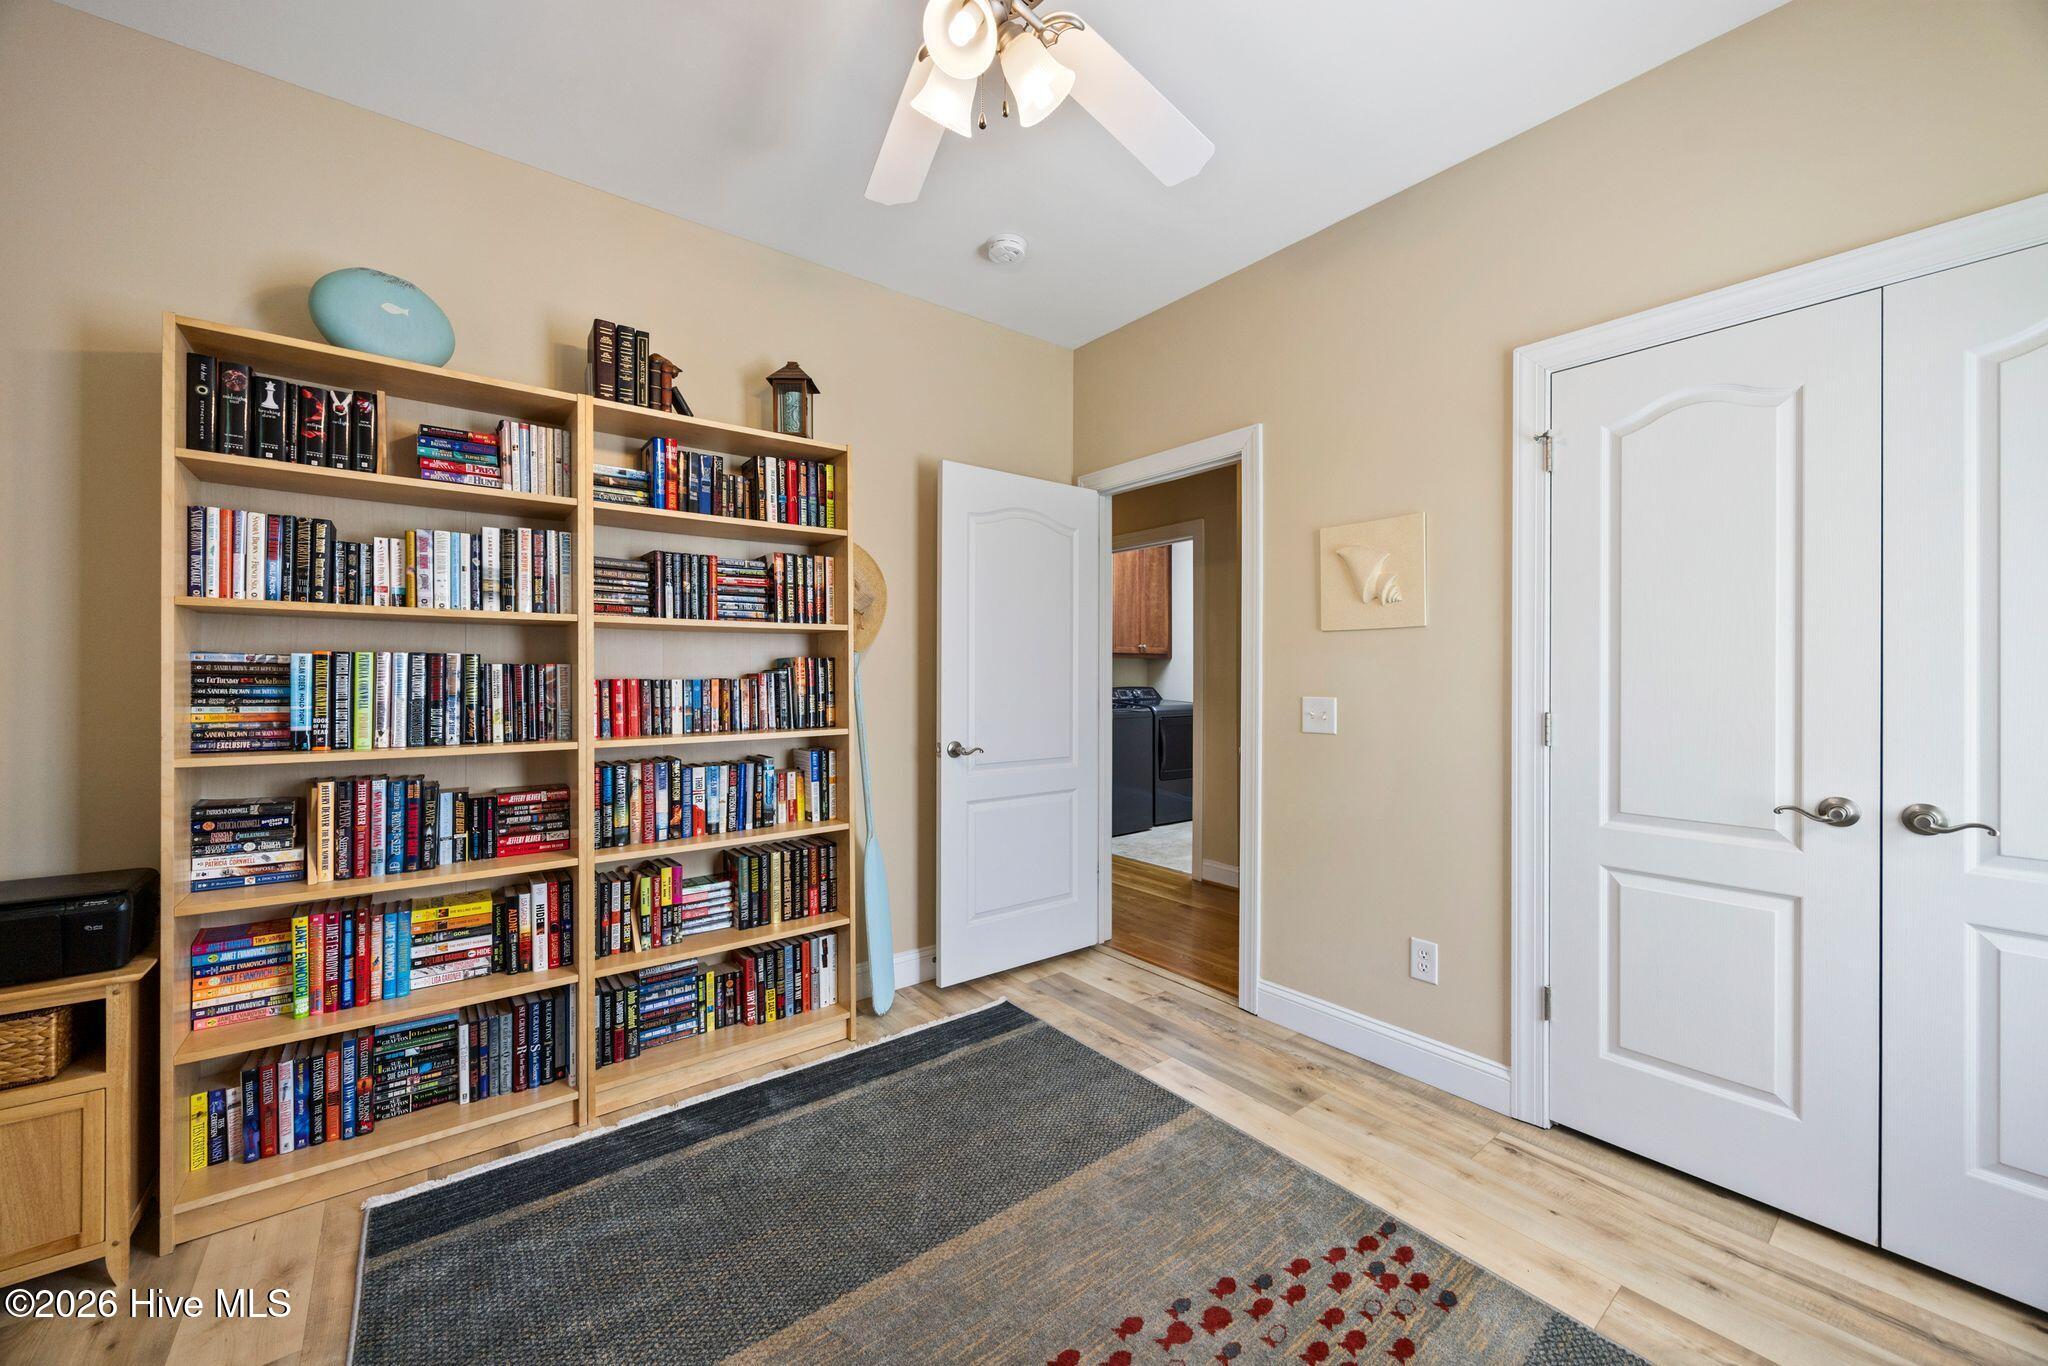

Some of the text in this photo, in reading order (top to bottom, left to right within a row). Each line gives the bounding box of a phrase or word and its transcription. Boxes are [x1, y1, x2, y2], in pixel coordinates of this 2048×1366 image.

[358, 653, 370, 710] PATRICIA CORNWELL
[216, 741, 251, 749] EXCLUSIVE
[321, 785, 330, 805] JEFFERY
[357, 783, 367, 825] JEFFERY DEAVER
[509, 795, 526, 803] JEFFERY
[526, 793, 542, 801] DEAVER
[321, 806, 330, 827] DEAVER
[339, 799, 351, 829] DEAVER
[425, 800, 436, 826] DEAVER
[644, 809, 654, 840] PATTERSON
[506, 834, 542, 845] JEFFERY DEAVER
[204, 858, 256, 868] PATRICIA CORNWELL
[508, 908, 518, 933] ALONE
[535, 904, 545, 923] HIDE
[295, 925, 308, 950] JANET
[219, 951, 236, 962] JANET
[325, 923, 339, 981] JANET EVANOVICH
[476, 947, 492, 956] HIDE
[219, 964, 236, 973] JANET
[236, 959, 267, 970] EVANOVICH
[294, 952, 308, 998] EVANOVICH
[216, 1005, 234, 1014] JANET
[627, 990, 638, 1029] John Sandford
[747, 990, 756, 1022] DRY ICE
[518, 1018, 526, 1045] GRAFTON
[545, 1012, 553, 1040] GRAFTON
[359, 1038, 369, 1079] TESS GERRITSEN
[530, 1043, 541, 1052] S
[343, 1045, 355, 1085] TESS GERRITSEN
[263, 1068, 273, 1105] TESS GERRITSEN
[312, 1057, 324, 1101] TESS GERRITSEN
[245, 1080, 254, 1116] TESS GERRITSEN
[217, 1117, 225, 1128] TESS
